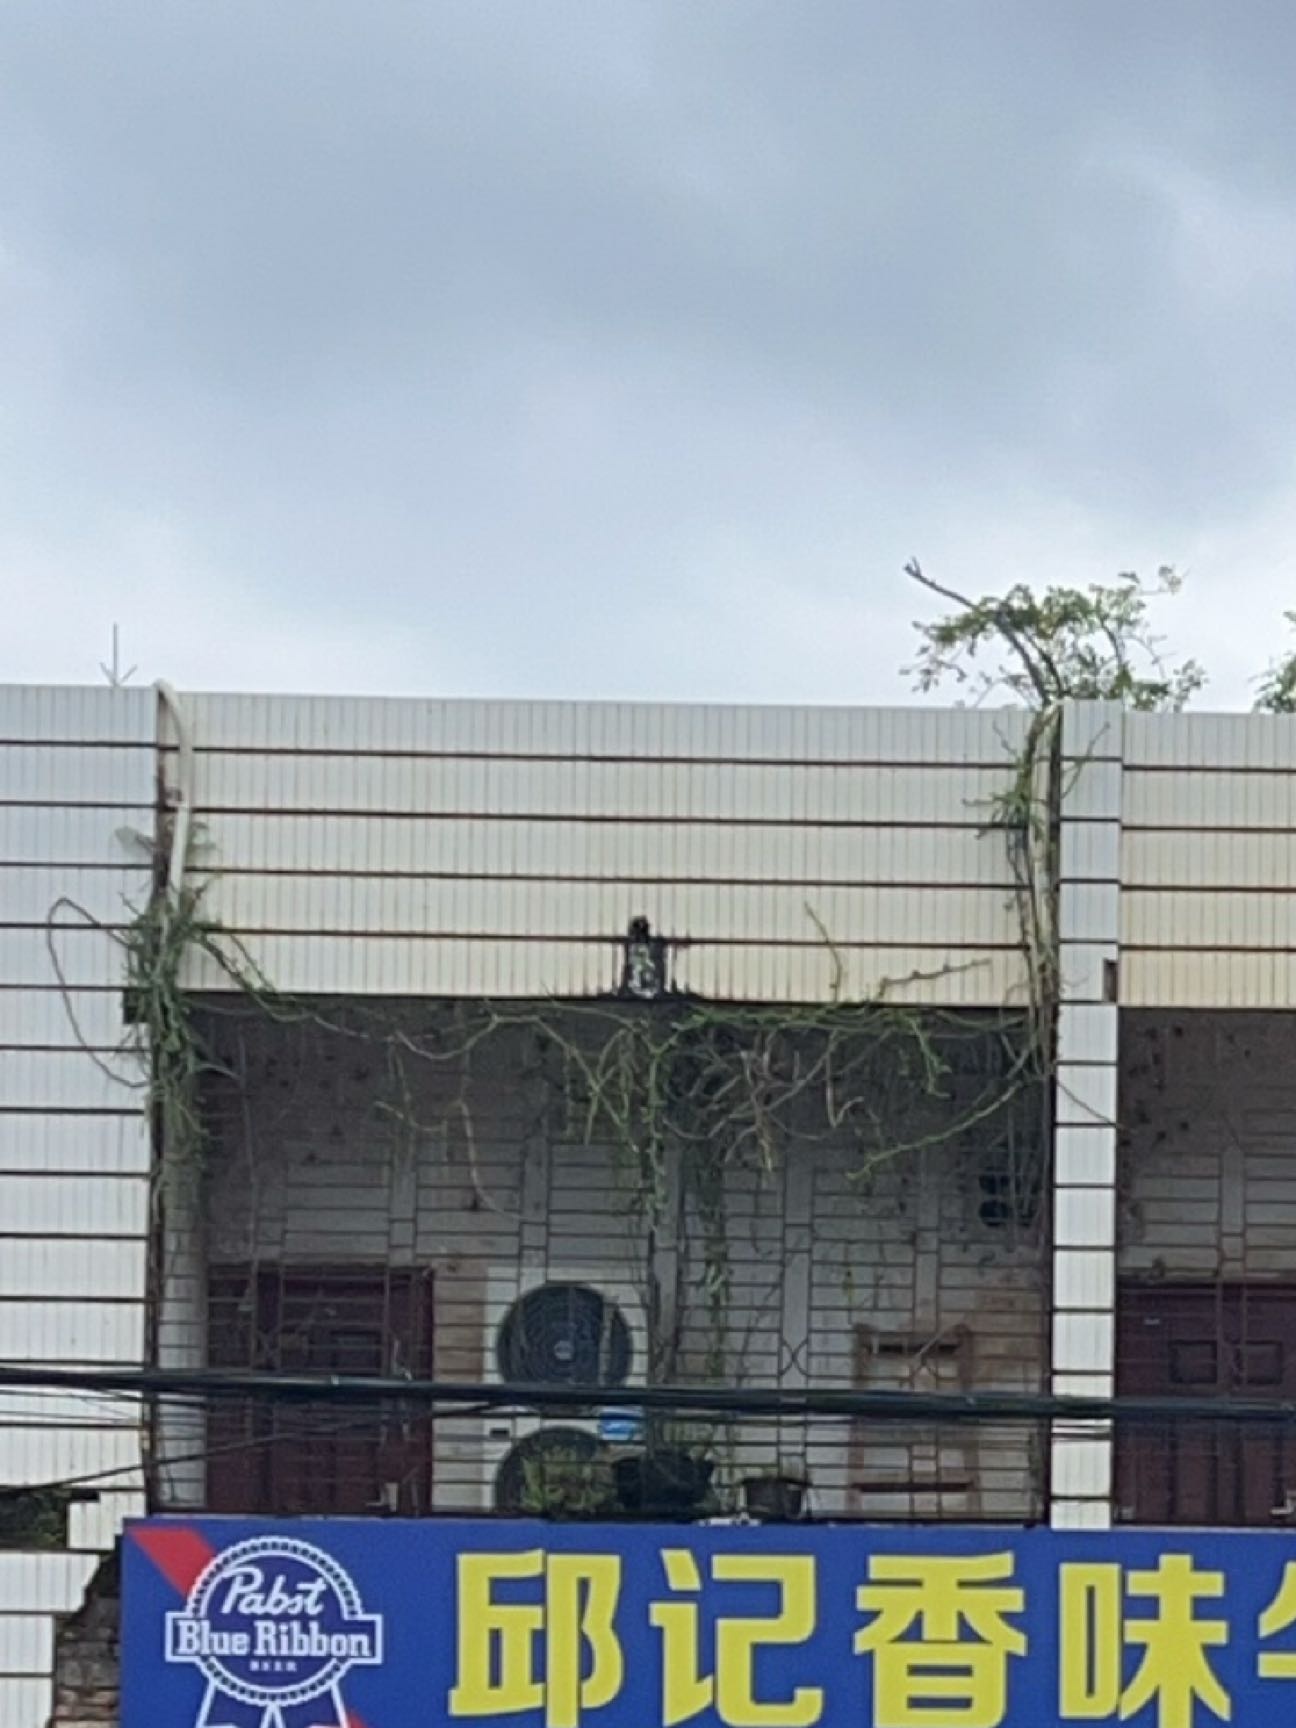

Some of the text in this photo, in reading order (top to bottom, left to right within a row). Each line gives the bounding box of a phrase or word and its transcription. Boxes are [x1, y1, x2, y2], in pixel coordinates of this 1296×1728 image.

[220, 1566, 326, 1615] Pabst
[176, 1620, 371, 1657] Blue Ribbon
